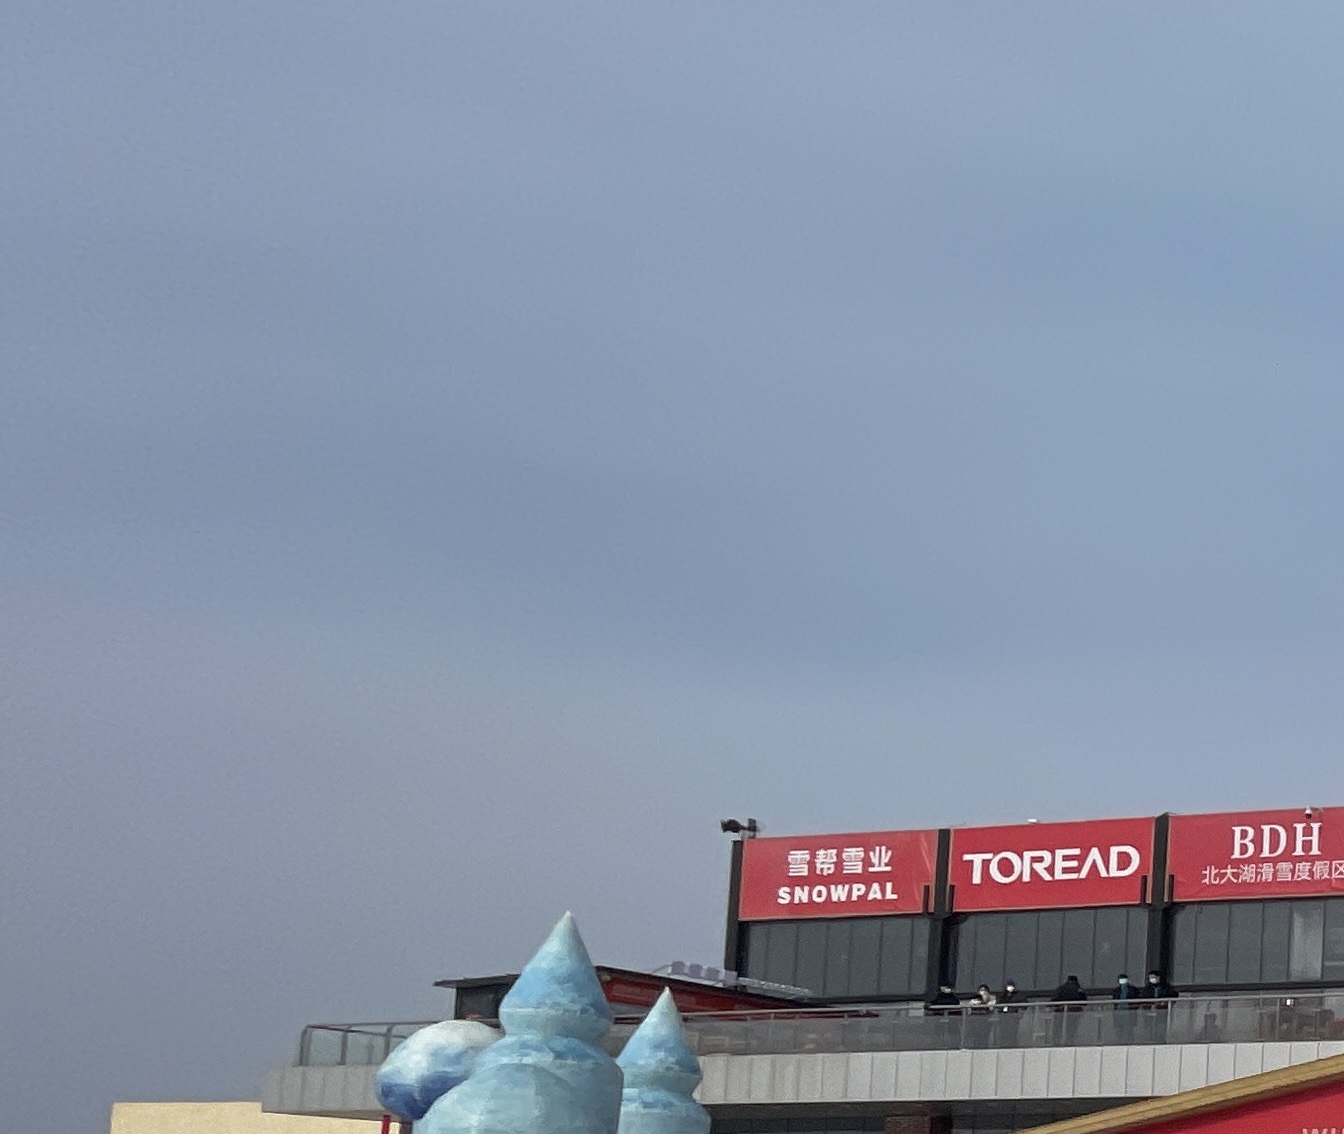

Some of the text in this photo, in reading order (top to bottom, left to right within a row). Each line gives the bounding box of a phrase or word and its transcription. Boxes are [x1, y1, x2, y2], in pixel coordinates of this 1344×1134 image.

[1231, 822, 1323, 860] BDH
[788, 845, 893, 877] 雪帮雪业
[962, 845, 1141, 885] TOREAD
[777, 881, 899, 905] SNOWPAL
